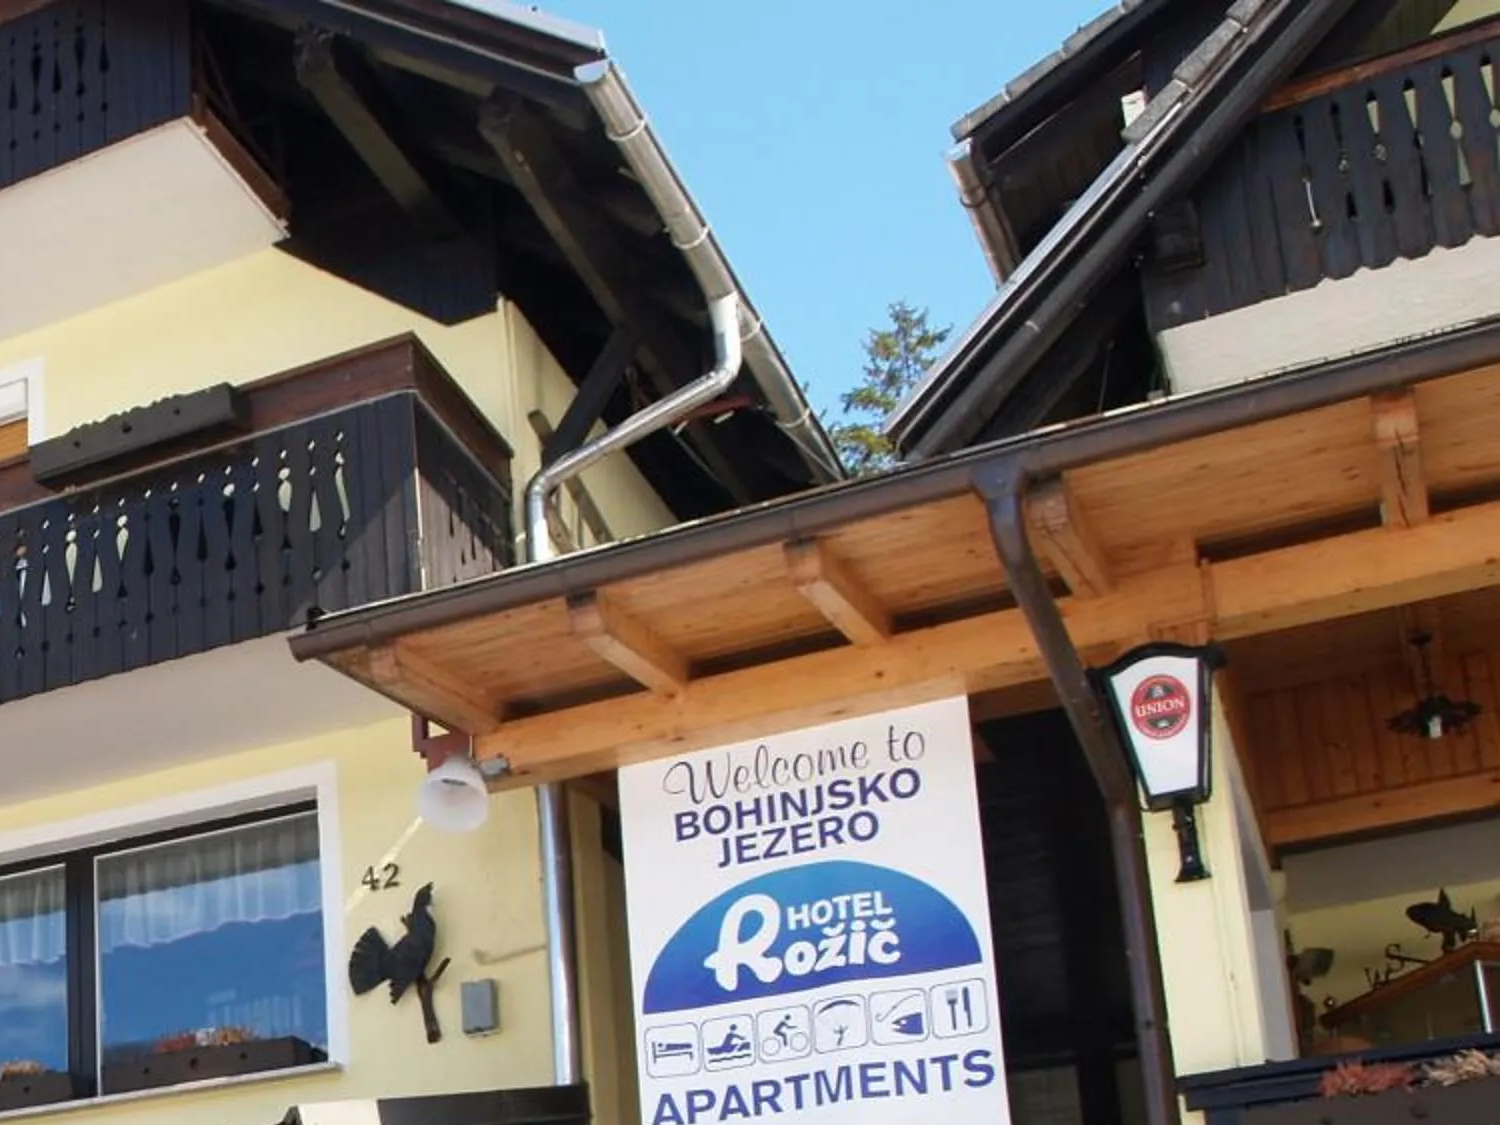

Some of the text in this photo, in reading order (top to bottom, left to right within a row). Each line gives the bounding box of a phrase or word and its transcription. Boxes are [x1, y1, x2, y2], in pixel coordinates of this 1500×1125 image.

[1136, 697, 1185, 717] UNION
[663, 724, 926, 805] Welcome to
[674, 766, 922, 843] BOHINJSKO
[717, 811, 881, 868] JEZERO
[361, 862, 400, 891] 42
[786, 890, 893, 931] HOTEL
